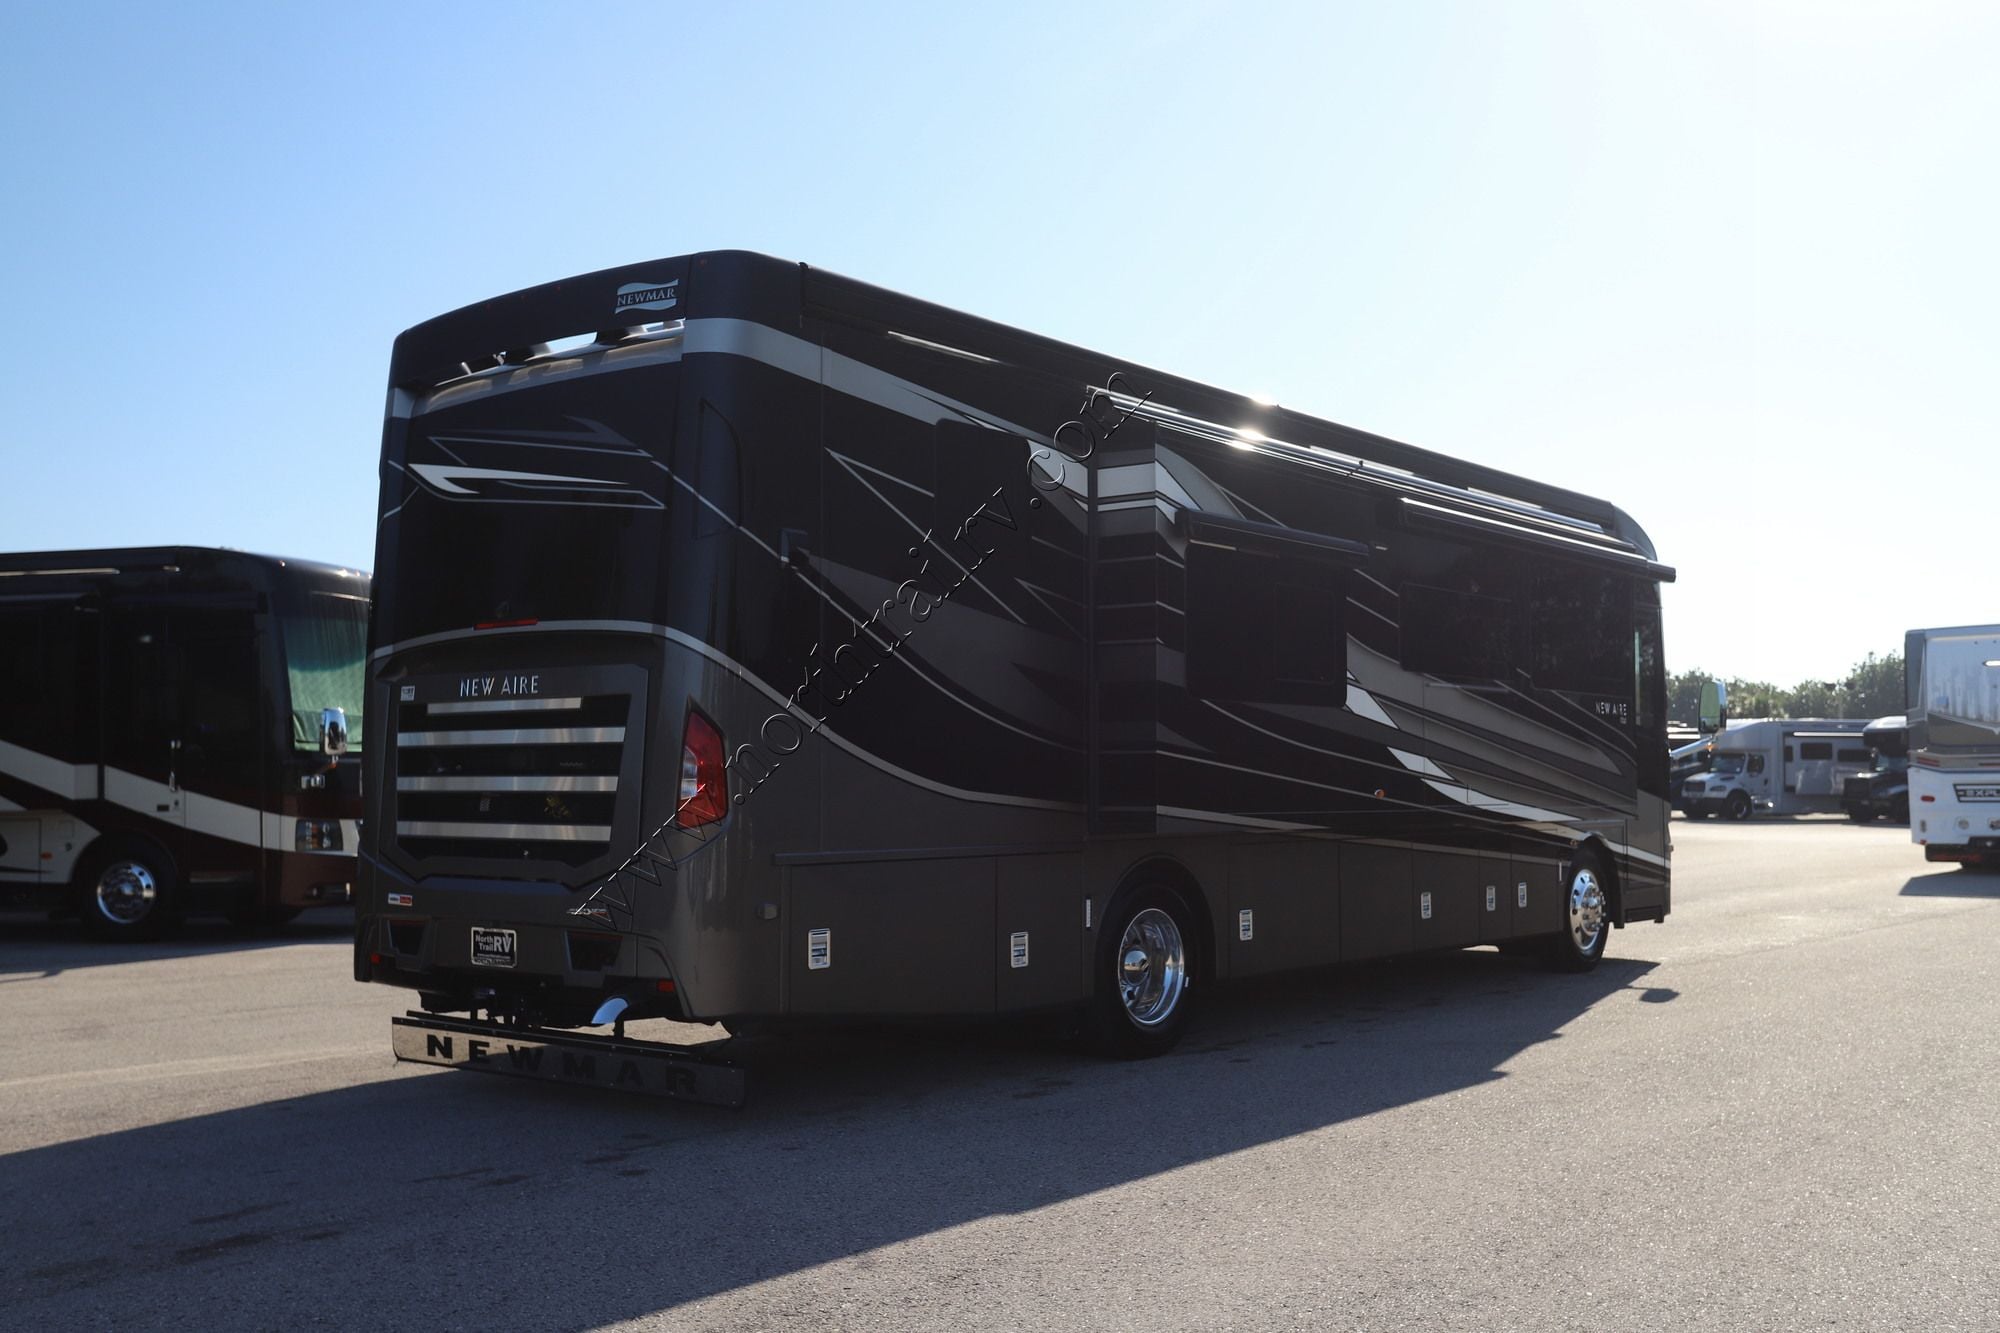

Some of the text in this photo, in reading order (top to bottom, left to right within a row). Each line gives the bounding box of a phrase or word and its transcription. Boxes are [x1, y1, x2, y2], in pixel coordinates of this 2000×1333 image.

[617, 288, 676, 306] NEWMAR
[460, 675, 539, 697] NEW AIRE
[1595, 701, 1627, 715] NEW AIRE
[475, 934, 494, 943] North
[479, 942, 494, 952] Trail
[493, 935, 512, 953] RV
[426, 1033, 698, 1093] NEWMAR
